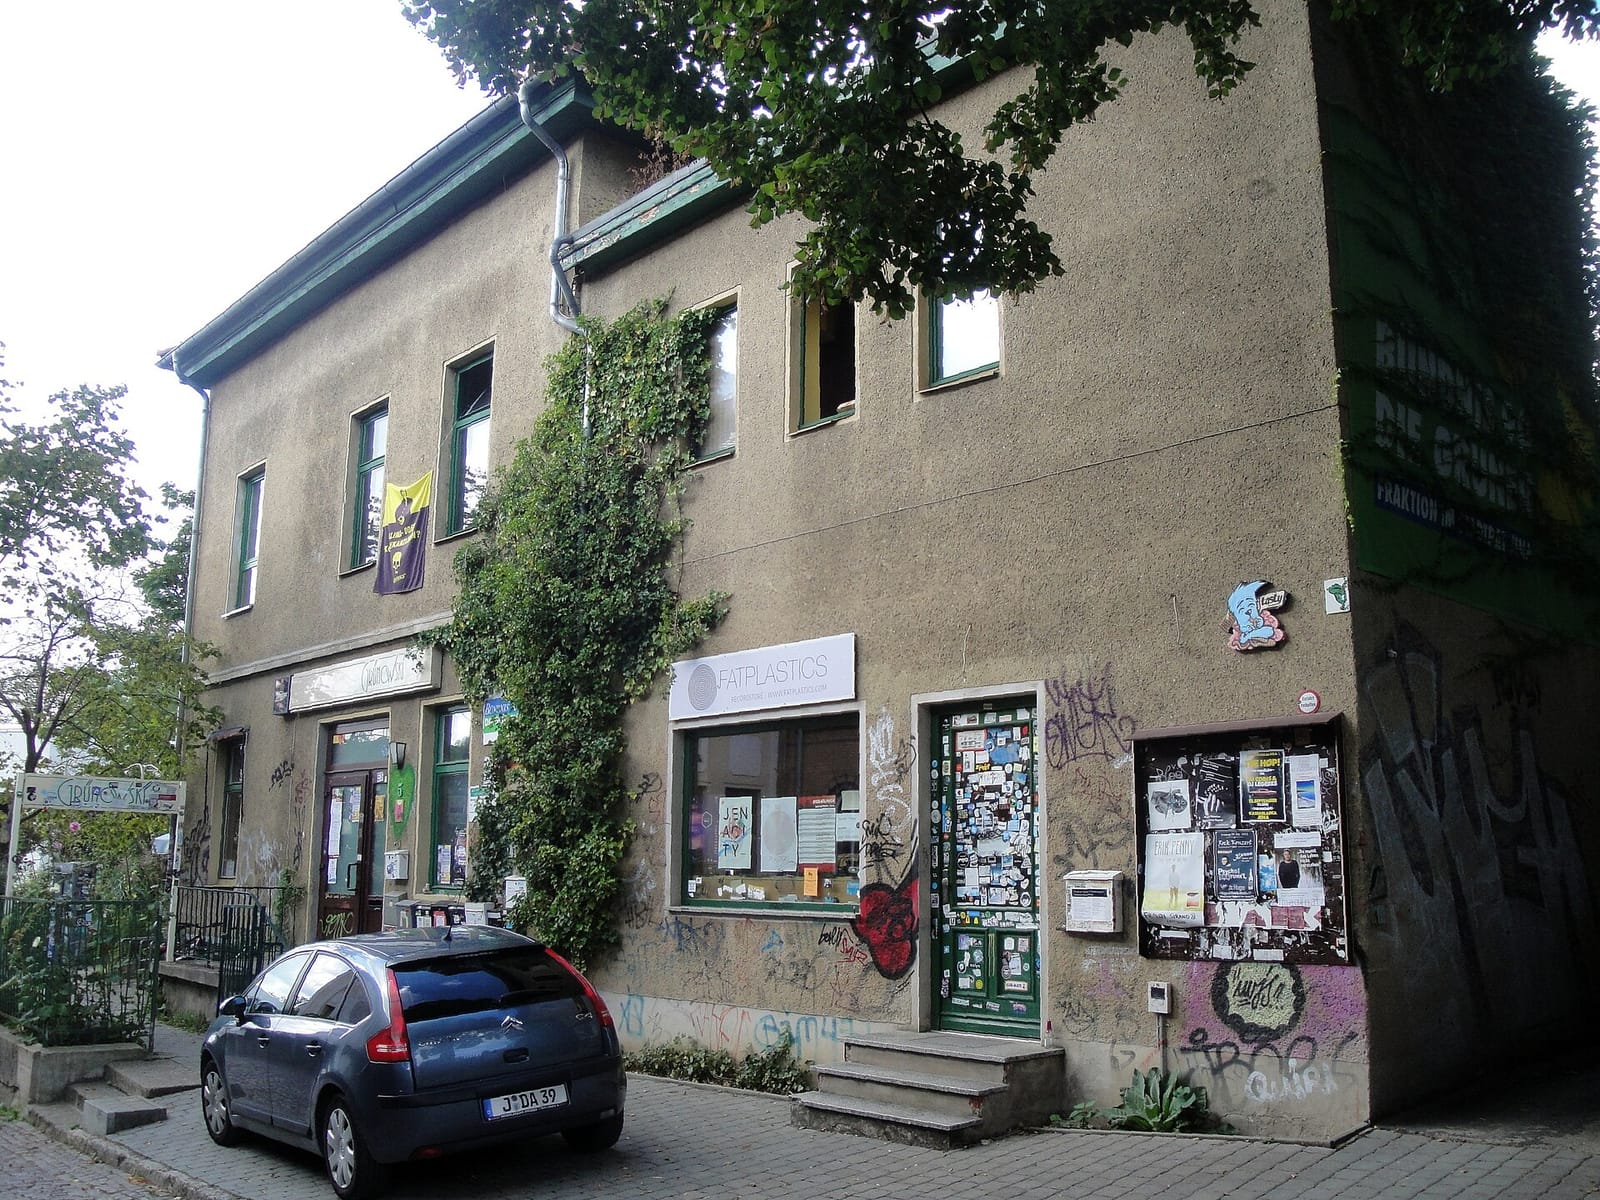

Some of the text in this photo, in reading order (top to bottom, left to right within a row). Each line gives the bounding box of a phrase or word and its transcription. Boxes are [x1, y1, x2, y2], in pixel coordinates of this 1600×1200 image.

[1376, 482, 1438, 524] FRAKTION
[717, 655, 828, 690] FATPLASTICS
[1260, 759, 1280, 767] HOP!
[503, 1097, 511, 1112] J
[520, 1092, 539, 1108] DA
[541, 1088, 556, 1104] 39
